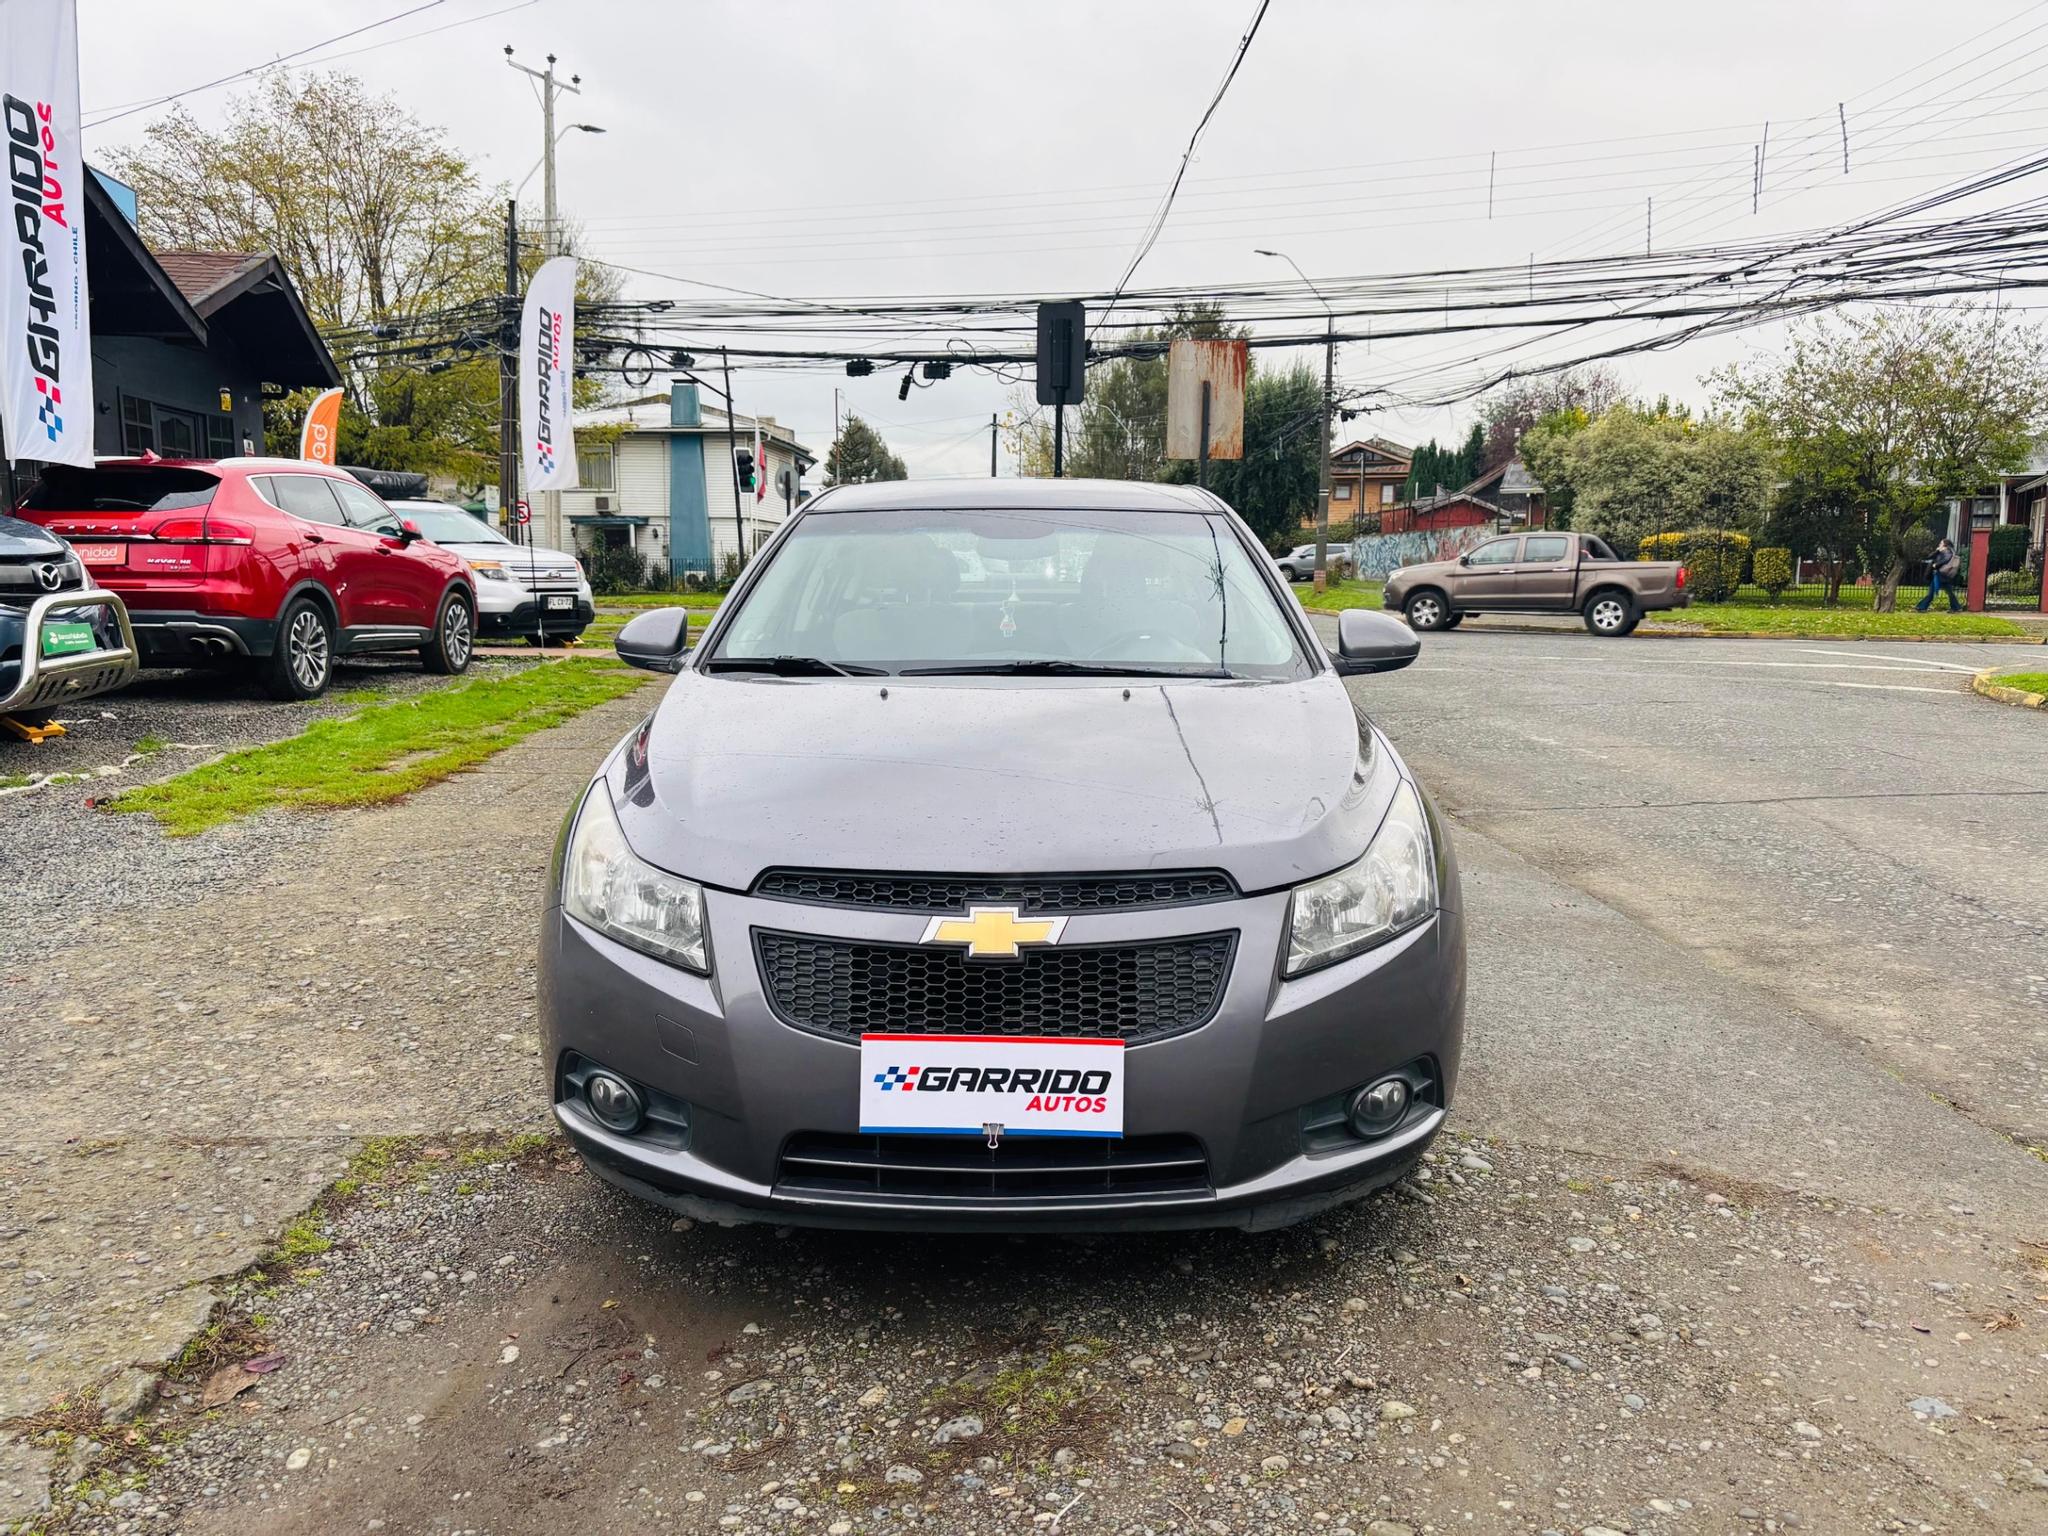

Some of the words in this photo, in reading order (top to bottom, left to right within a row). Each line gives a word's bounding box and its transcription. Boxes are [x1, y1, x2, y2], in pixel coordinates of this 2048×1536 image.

[36, 100, 68, 228] AUTOS
[2, 93, 60, 384] GARRIDO
[537, 306, 553, 445] GARRIDO
[552, 312, 562, 371] AUTOS
[917, 1066, 1112, 1094] GARRIDO
[1025, 1095, 1107, 1113] AUTOS
